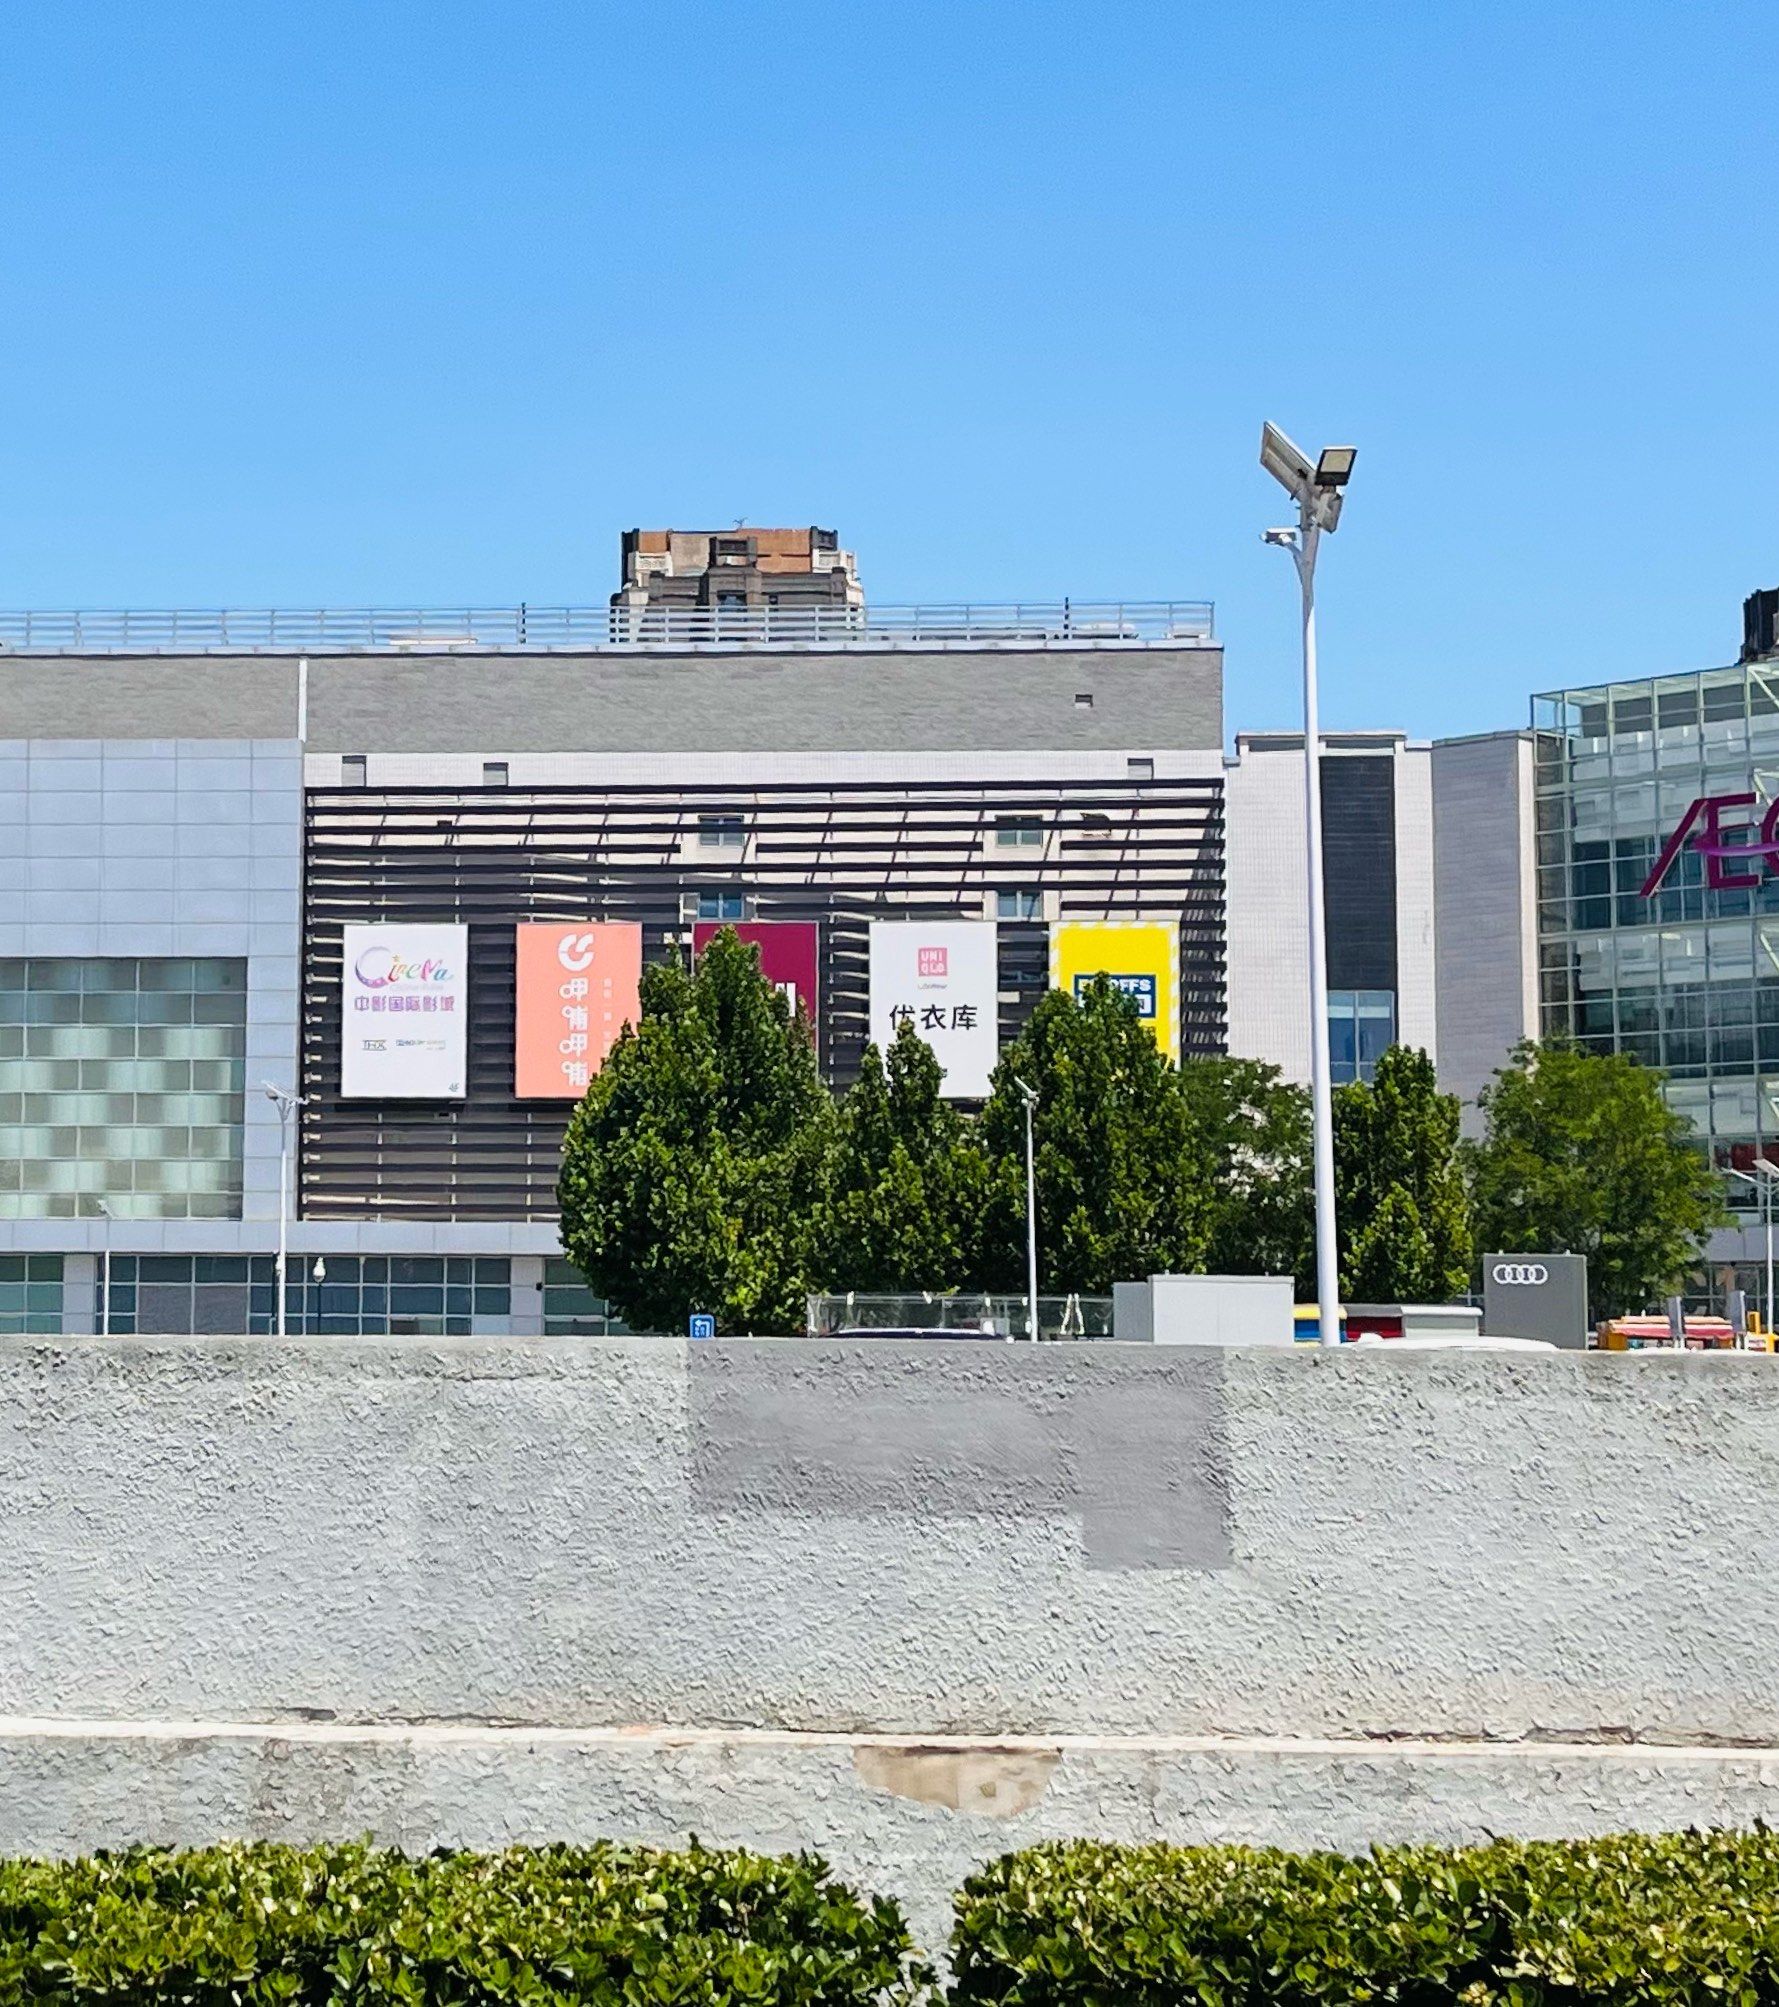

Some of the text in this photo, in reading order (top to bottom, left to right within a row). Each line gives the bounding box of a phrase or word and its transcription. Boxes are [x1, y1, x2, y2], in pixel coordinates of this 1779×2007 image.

[921, 950, 943, 962] UNI
[921, 962, 945, 974] QLO
[889, 1003, 978, 1031] 优衣库
